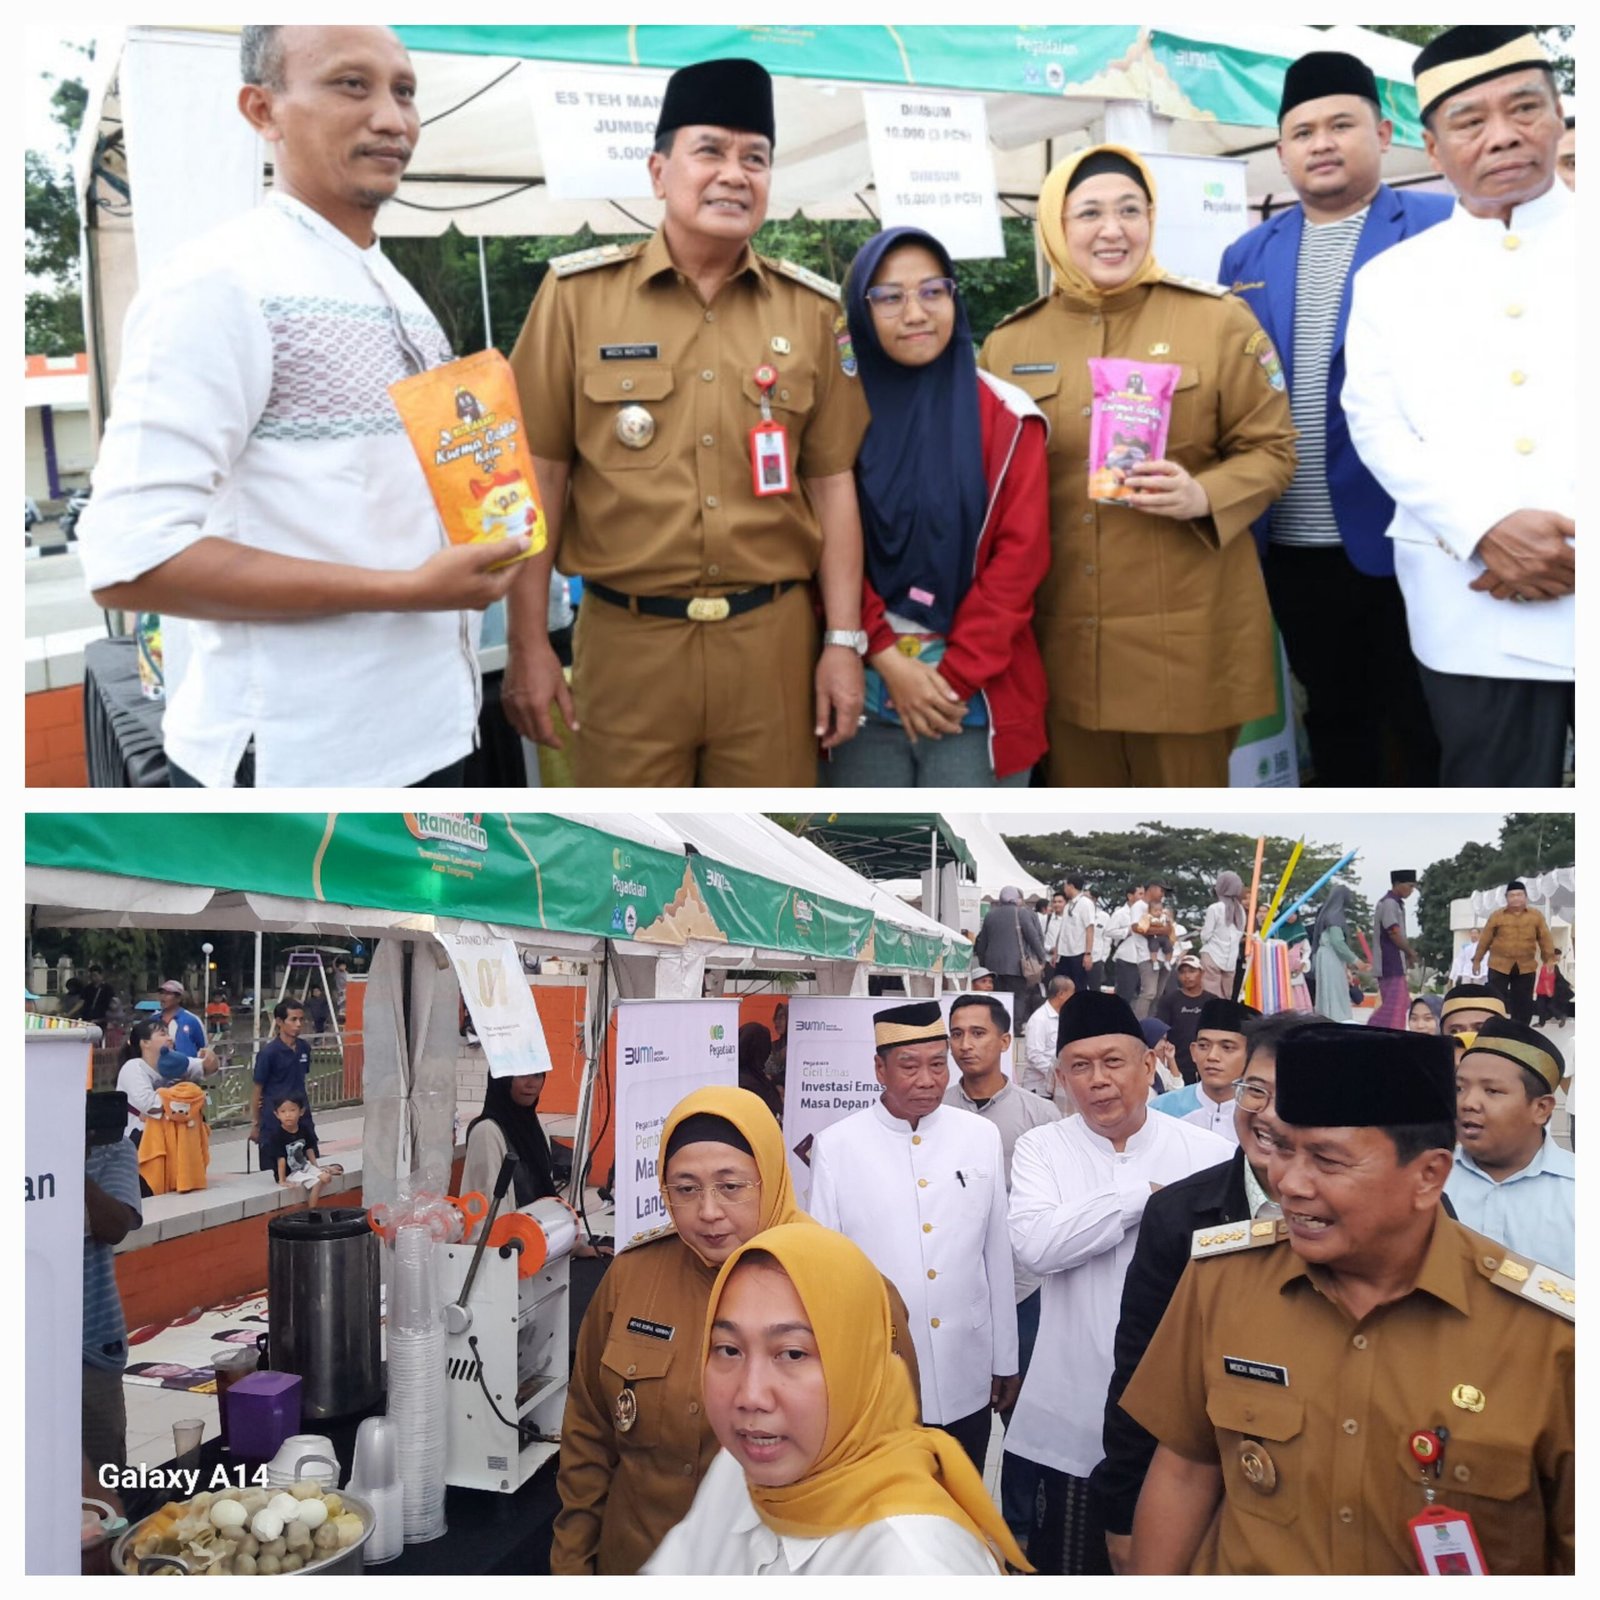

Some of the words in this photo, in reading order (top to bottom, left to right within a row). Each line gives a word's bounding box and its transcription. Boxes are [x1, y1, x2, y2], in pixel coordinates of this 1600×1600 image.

[555, 91, 580, 105] ES
[585, 92, 621, 107] TEH
[901, 103, 951, 118] DIMSUM
[594, 119, 657, 134] JUMBO
[419, 812, 487, 847] Ramadan
[802, 1081, 853, 1092] Investasi
[855, 1082, 886, 1092] Emas
[801, 1098, 831, 1109] Masa
[834, 1098, 870, 1111] Depan
